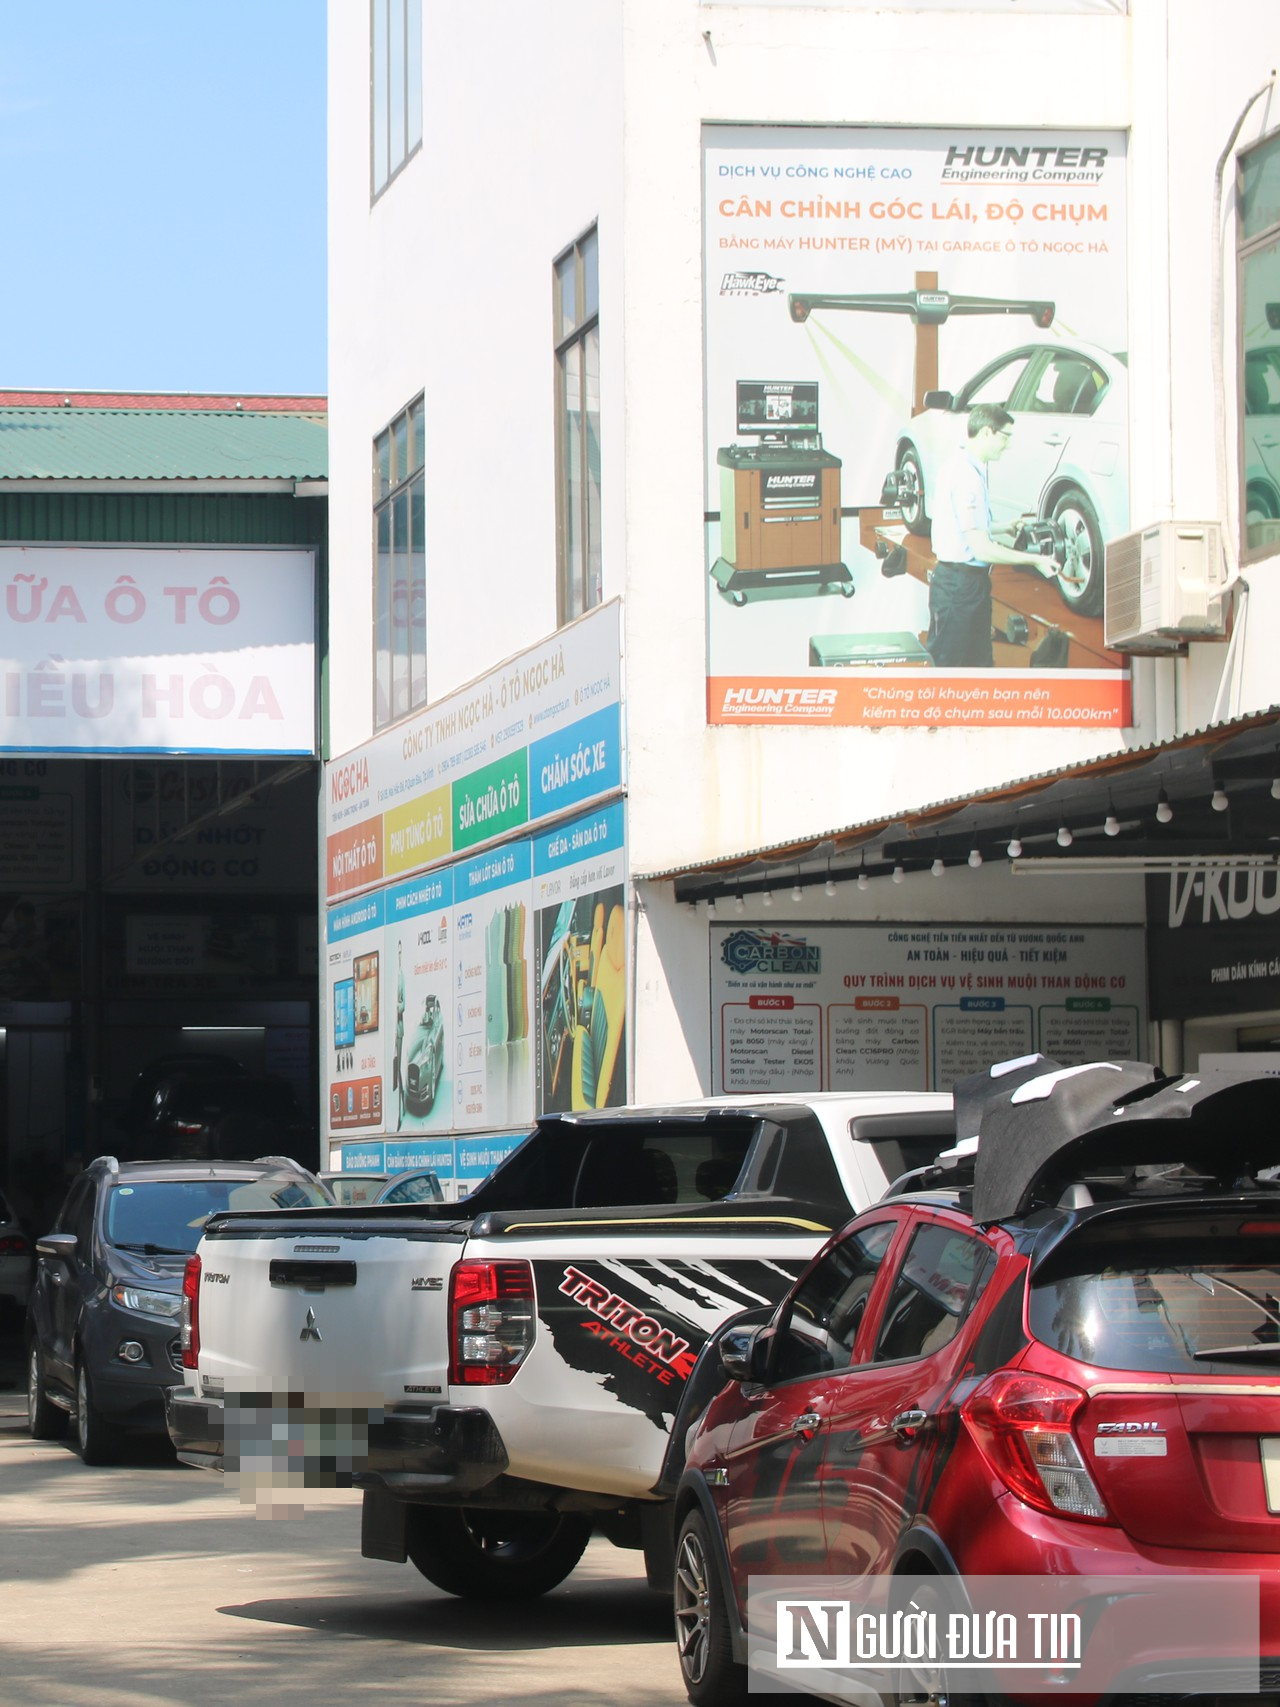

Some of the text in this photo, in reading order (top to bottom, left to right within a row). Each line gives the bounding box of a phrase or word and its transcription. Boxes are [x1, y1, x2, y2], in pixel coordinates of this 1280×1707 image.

[945, 146, 1108, 167] HUNTER
[719, 165, 912, 181] DỊCH VỤ CÔNG NGHỆ CAO
[942, 168, 1103, 182] Engineering Company
[719, 195, 1107, 226] CÂN CHỈNH GÓC LÁI, ĐỘ CHỤM
[720, 234, 1108, 255] BẰNG MÁY HUNTER (MỸ) TẠI GARAGE Ô TÔ NGỌC HÀ
[722, 273, 777, 291] HawkEye
[768, 475, 815, 483] HUNTER
[104, 575, 146, 625] Ô
[164, 576, 240, 625] TÔ
[142, 662, 284, 721] HÒA
[725, 688, 838, 704] HUNTER
[918, 688, 935, 699] tôi
[939, 688, 989, 701] khuyên
[994, 689, 1019, 701] bạn
[1024, 690, 1049, 700] nên
[403, 730, 423, 760] CÔNG
[425, 724, 433, 749] TY
[436, 712, 456, 744] TNHH
[458, 698, 480, 732] NGỌC
[482, 684, 493, 719] HÀ
[523, 659, 548, 696] NGỌC
[551, 644, 565, 682] HÀ
[722, 704, 834, 714] Engineering Company
[863, 706, 896, 718] kiểm
[900, 709, 919, 718] tra
[924, 707, 941, 721] độ
[945, 708, 983, 721] chụm
[988, 710, 1012, 719] sau
[1017, 706, 1043, 719] mỗi
[541, 740, 605, 794] CHĂM SÓC XE
[459, 794, 475, 830] SỬA
[476, 784, 498, 822] CHỮA
[142, 855, 258, 881] ĐỘNG CƠ
[1168, 860, 1280, 928] V-KOO
[888, 932, 908, 942] CÔNG
[736, 948, 818, 959] CARBON
[907, 947, 1068, 965] AN TOÀN HIỆU QUẢ TIẾT KIỆM
[758, 961, 818, 973] CLEAN
[1211, 959, 1267, 983] PHIM DÁN KÍNH
[843, 972, 1126, 991] QUY TRÌNH DỊCH VỤ VỆ SINH MUỘI THAN ĐỘNG CƠ
[757, 998, 780, 1006] BƯỚC
[558, 1265, 689, 1363] TRITON
[580, 1321, 675, 1386] ATHLETE
[1097, 1422, 1167, 1434] FADIL
